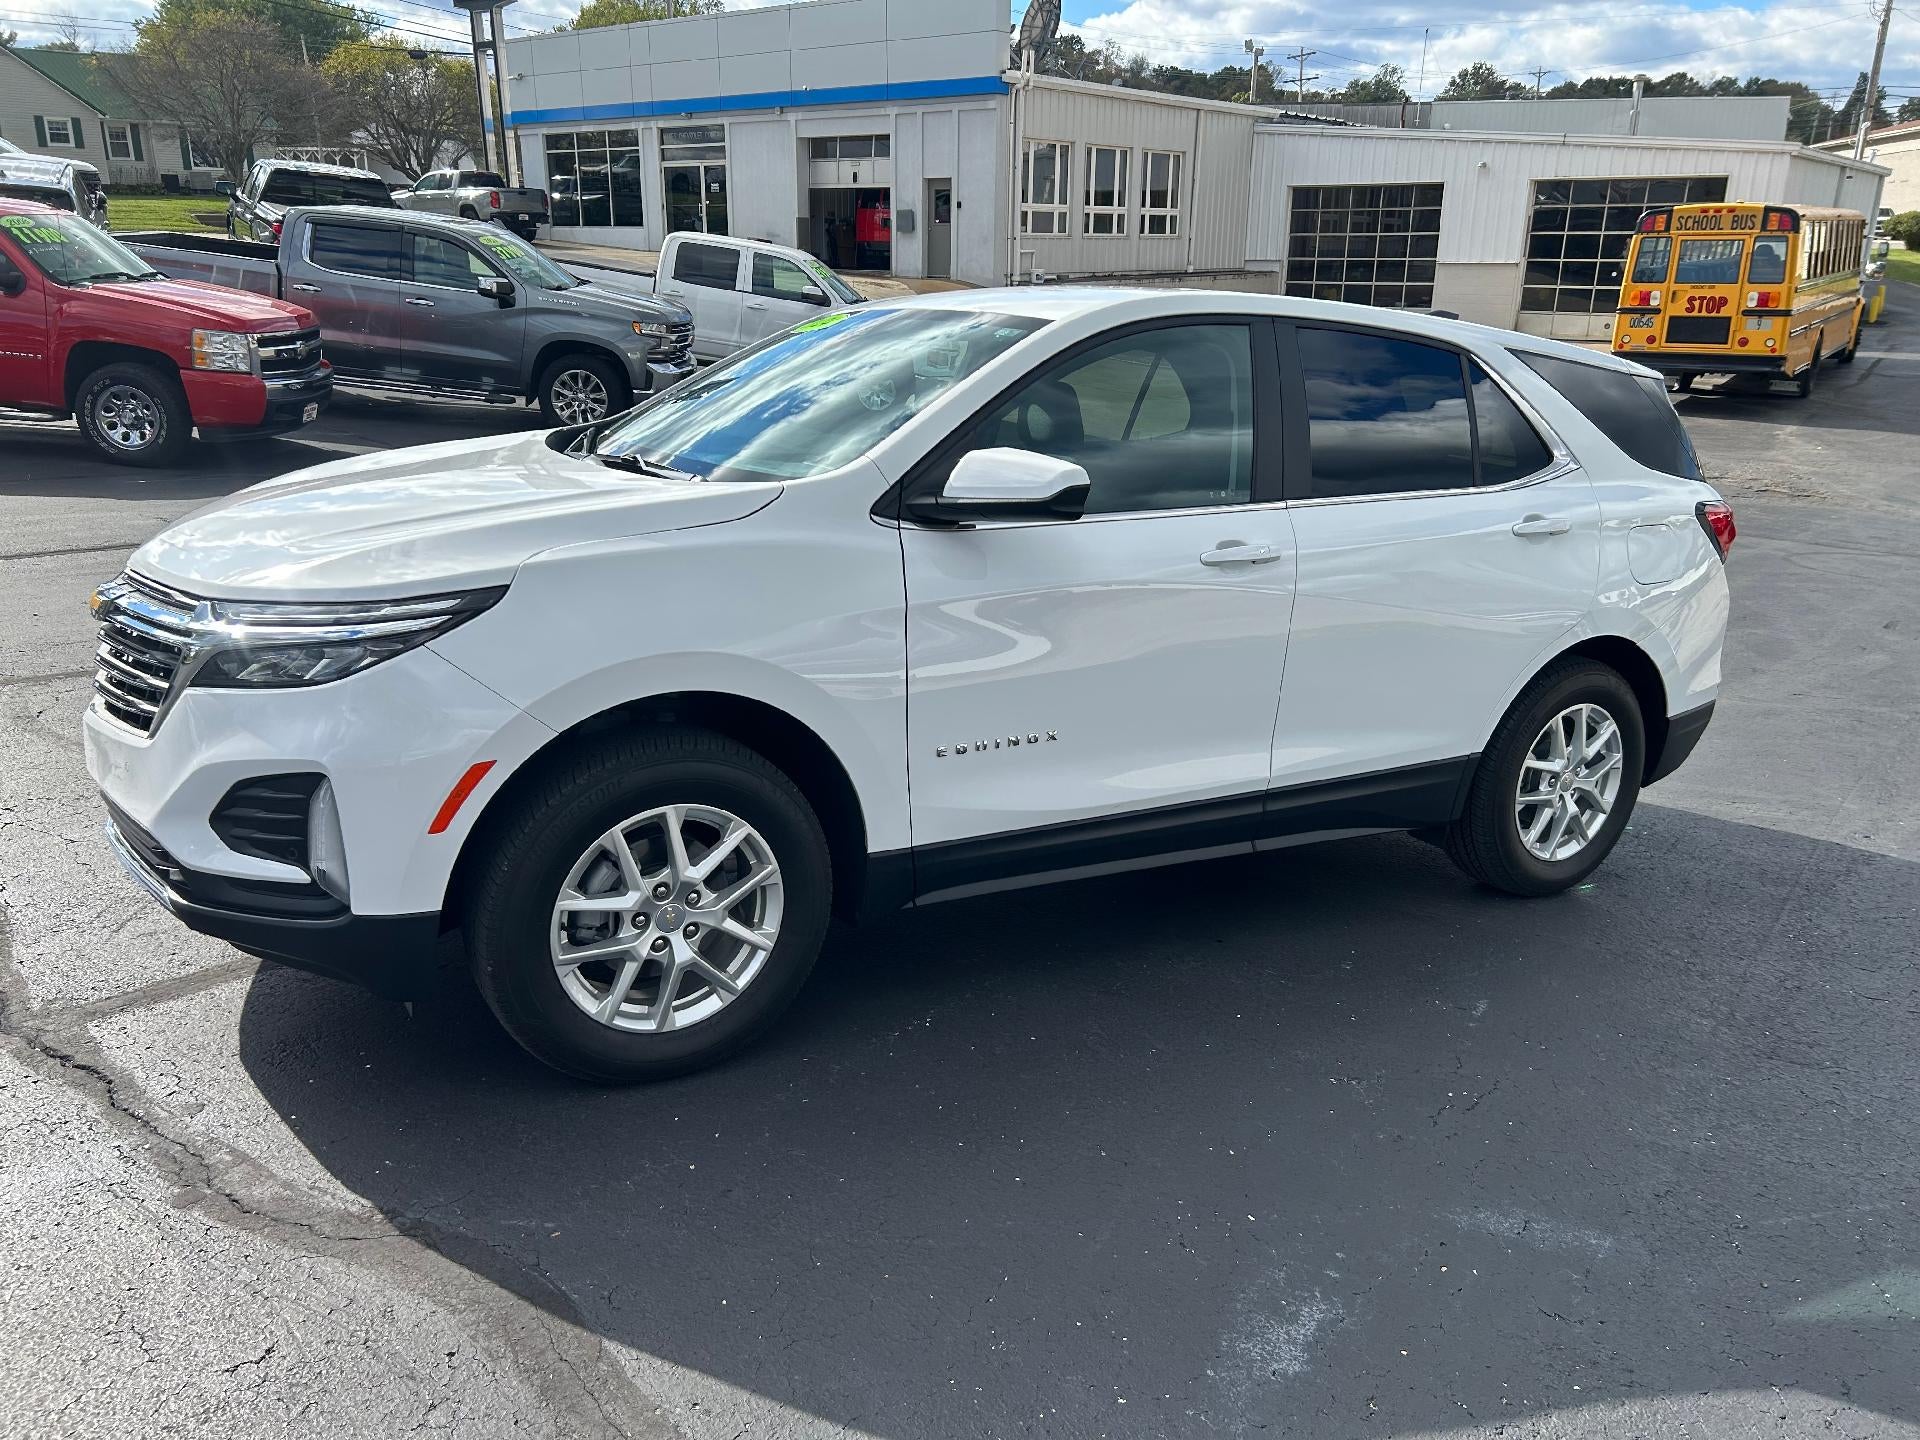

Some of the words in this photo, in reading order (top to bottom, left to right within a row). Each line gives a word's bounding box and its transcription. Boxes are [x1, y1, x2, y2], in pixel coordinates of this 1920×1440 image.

[1676, 214, 1724, 231] SCHOOL
[1730, 214, 1757, 231] BUS
[1685, 295, 1729, 314] STOP
[1756, 319, 1763, 330] 9
[936, 730, 1058, 758] EQUINOX
